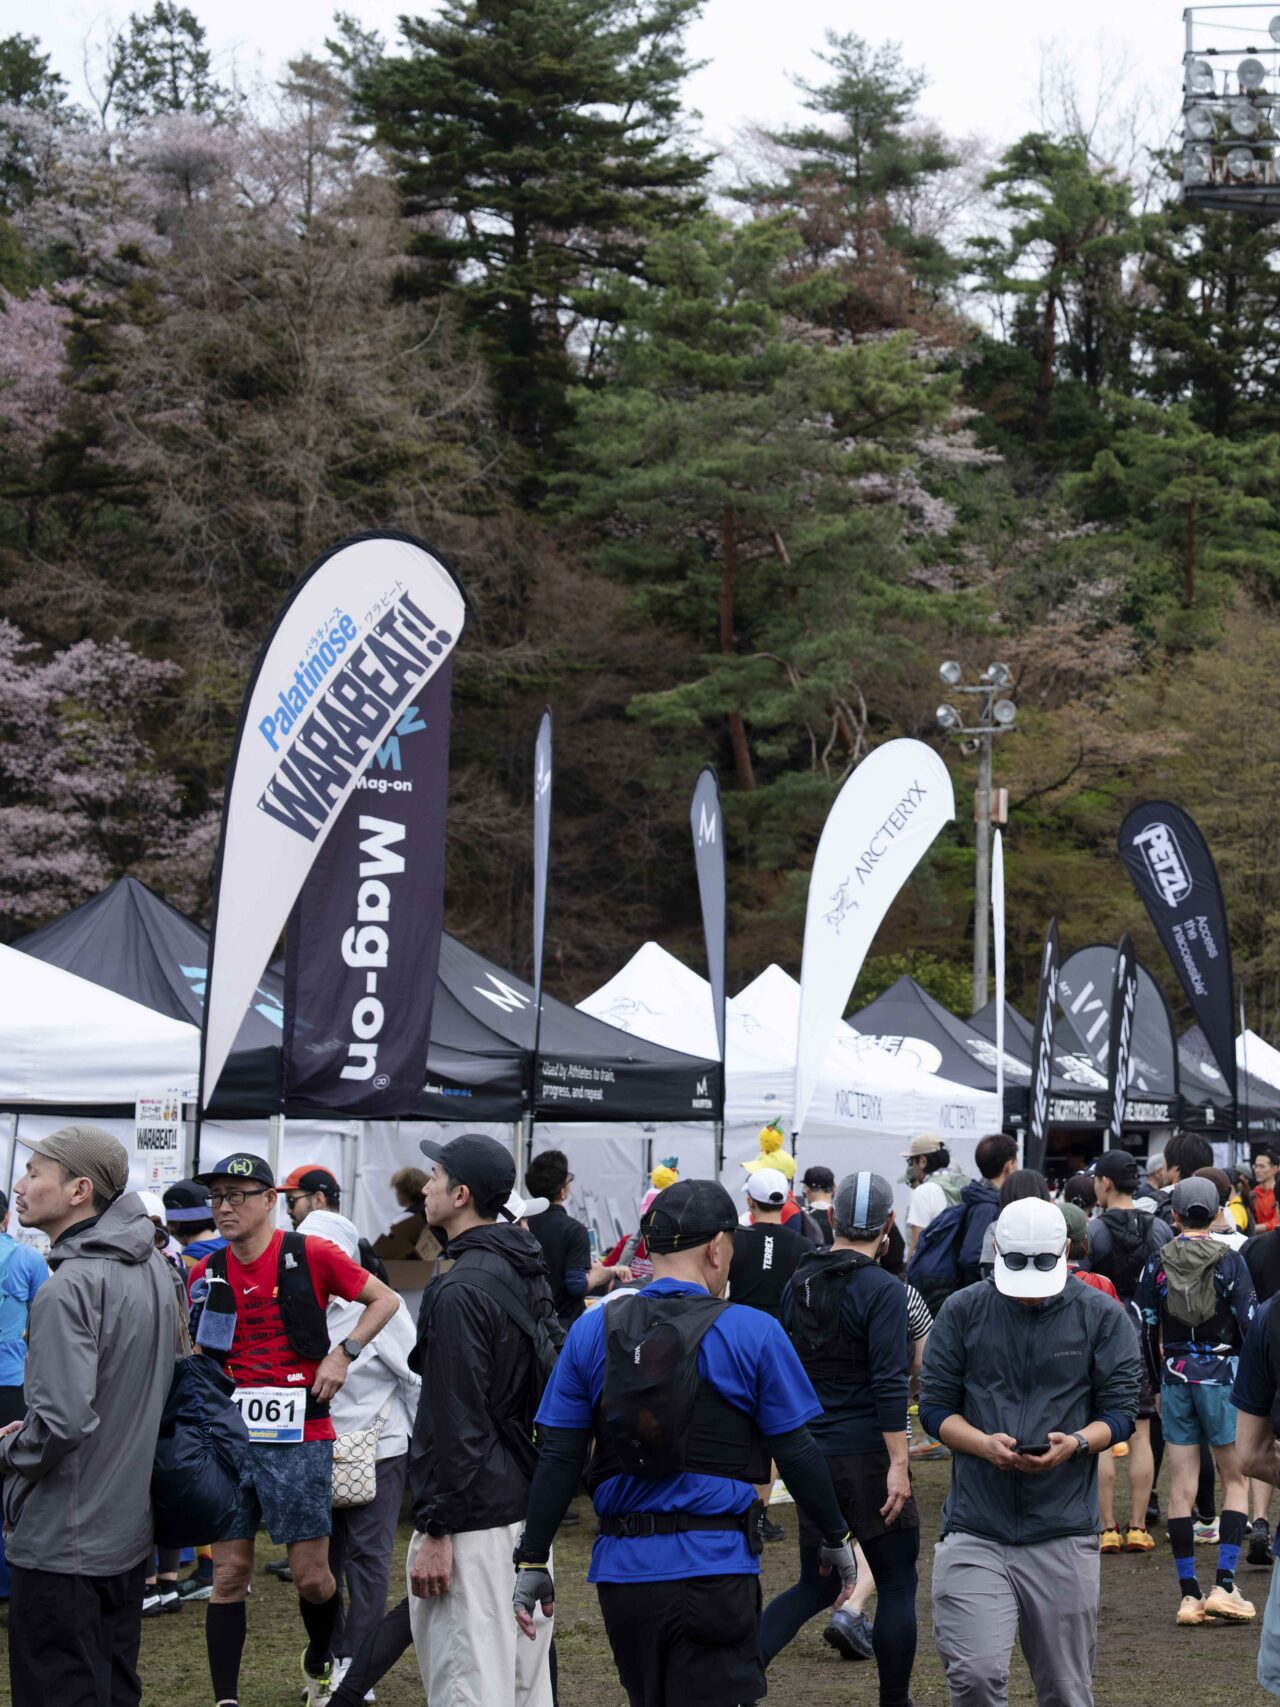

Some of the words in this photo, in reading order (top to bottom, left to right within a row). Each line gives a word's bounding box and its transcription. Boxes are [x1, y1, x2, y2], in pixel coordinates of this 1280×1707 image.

[258, 613, 354, 752] Palatinose
[257, 590, 452, 843] WARABEAT!!
[352, 776, 412, 793] Mag-on
[1133, 824, 1188, 908] PETZL
[340, 815, 406, 1081] Mag-on
[1184, 919, 1198, 940] the
[1195, 915, 1218, 960] Access
[137, 1127, 177, 1150] WARABEAT!!
[763, 1236, 774, 1270] TERREX
